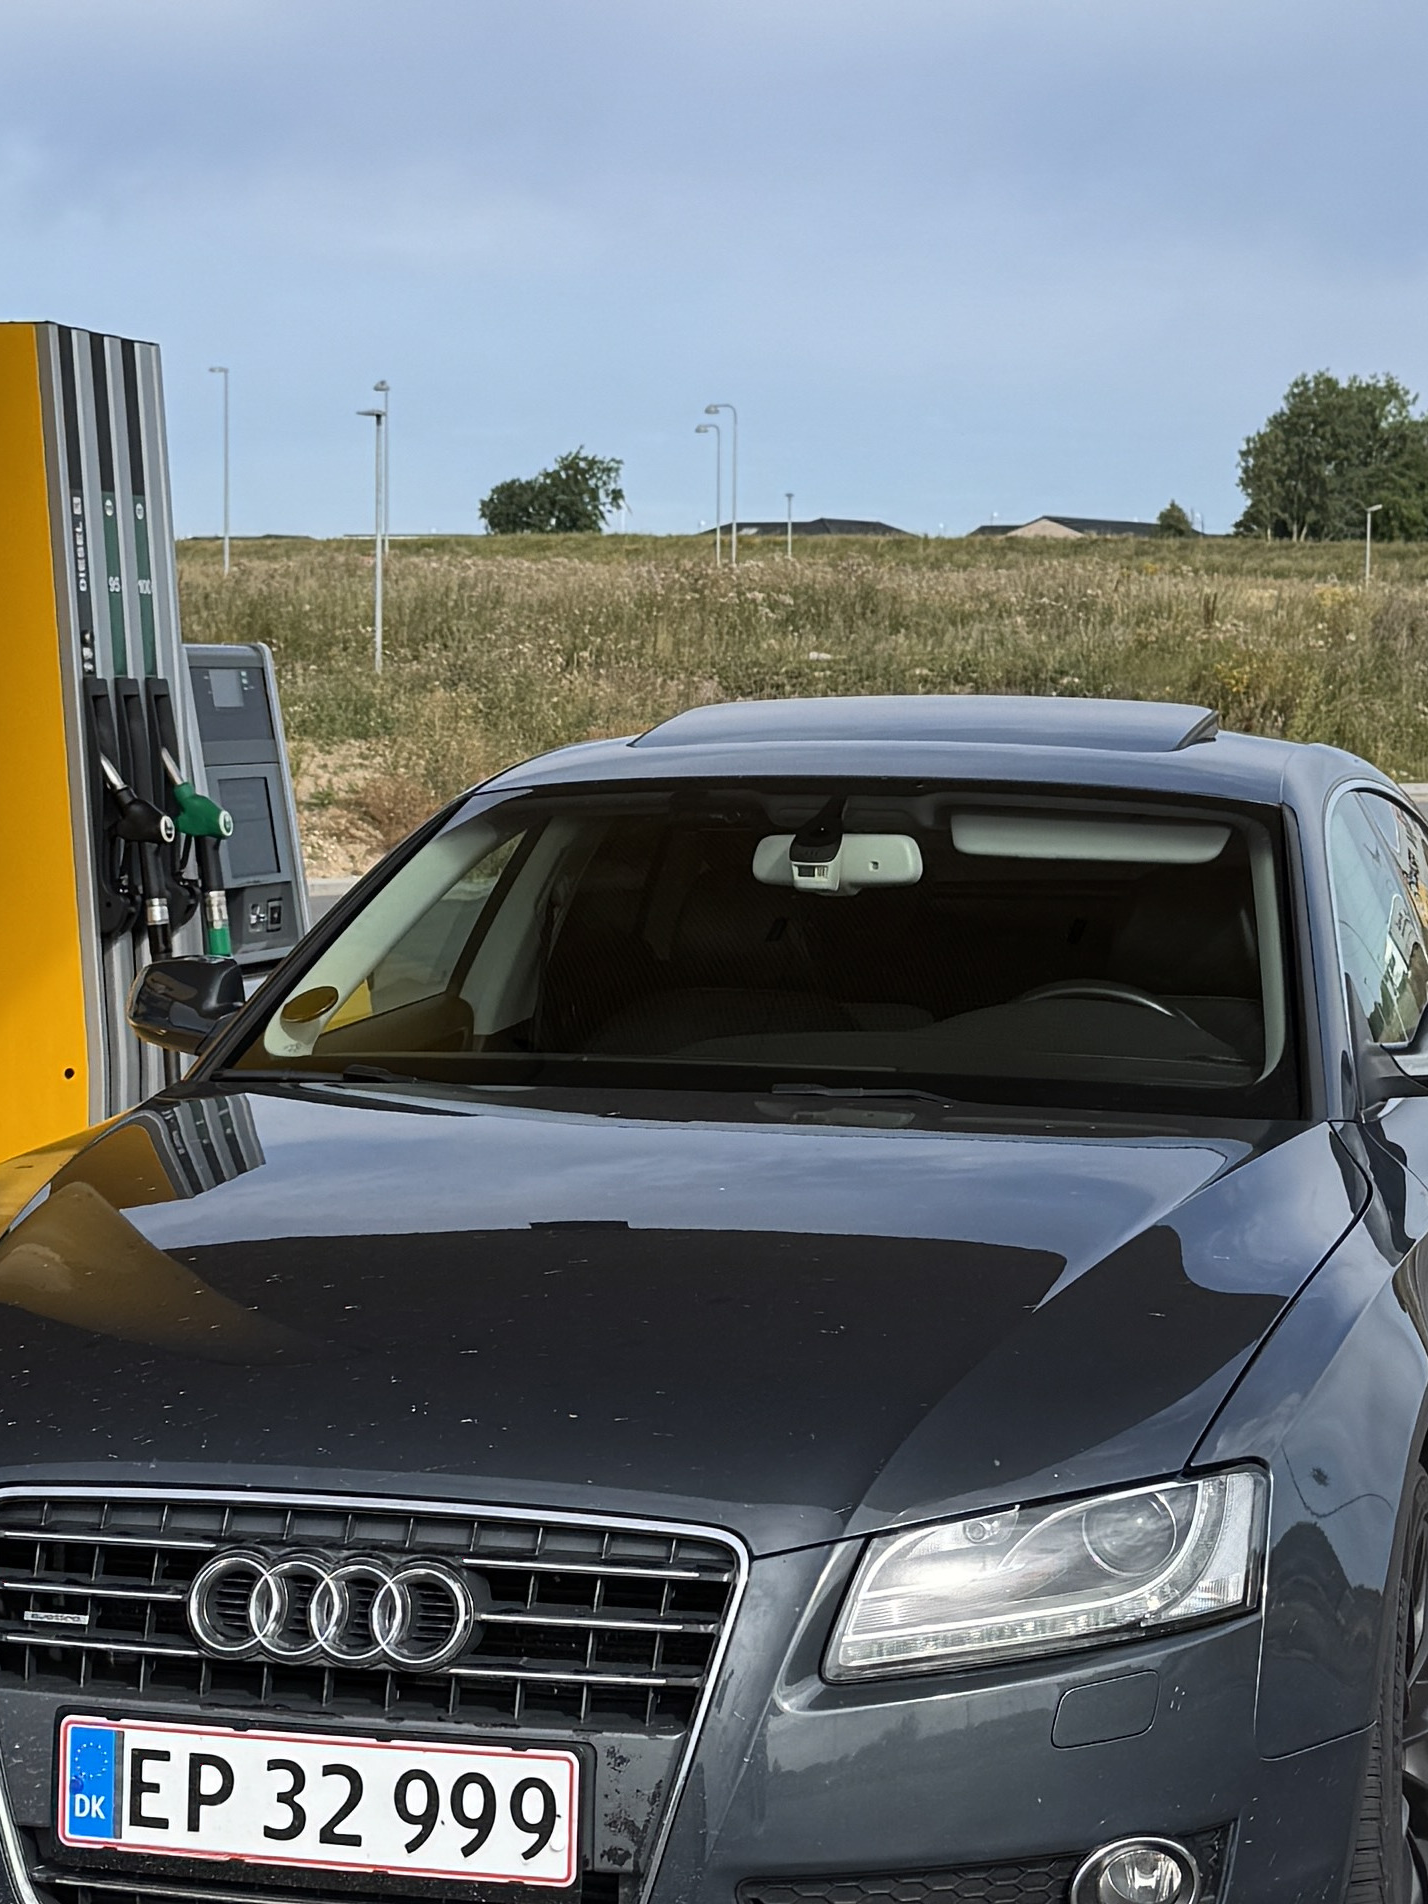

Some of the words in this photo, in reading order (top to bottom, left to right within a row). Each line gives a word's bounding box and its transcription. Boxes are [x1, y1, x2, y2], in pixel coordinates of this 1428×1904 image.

[74, 521, 88, 592] DIESEL
[108, 576, 121, 593] 95
[73, 1794, 107, 1821] DK
[128, 1747, 234, 1833] EP
[263, 1758, 364, 1848] 32
[393, 1768, 558, 1862] 999
